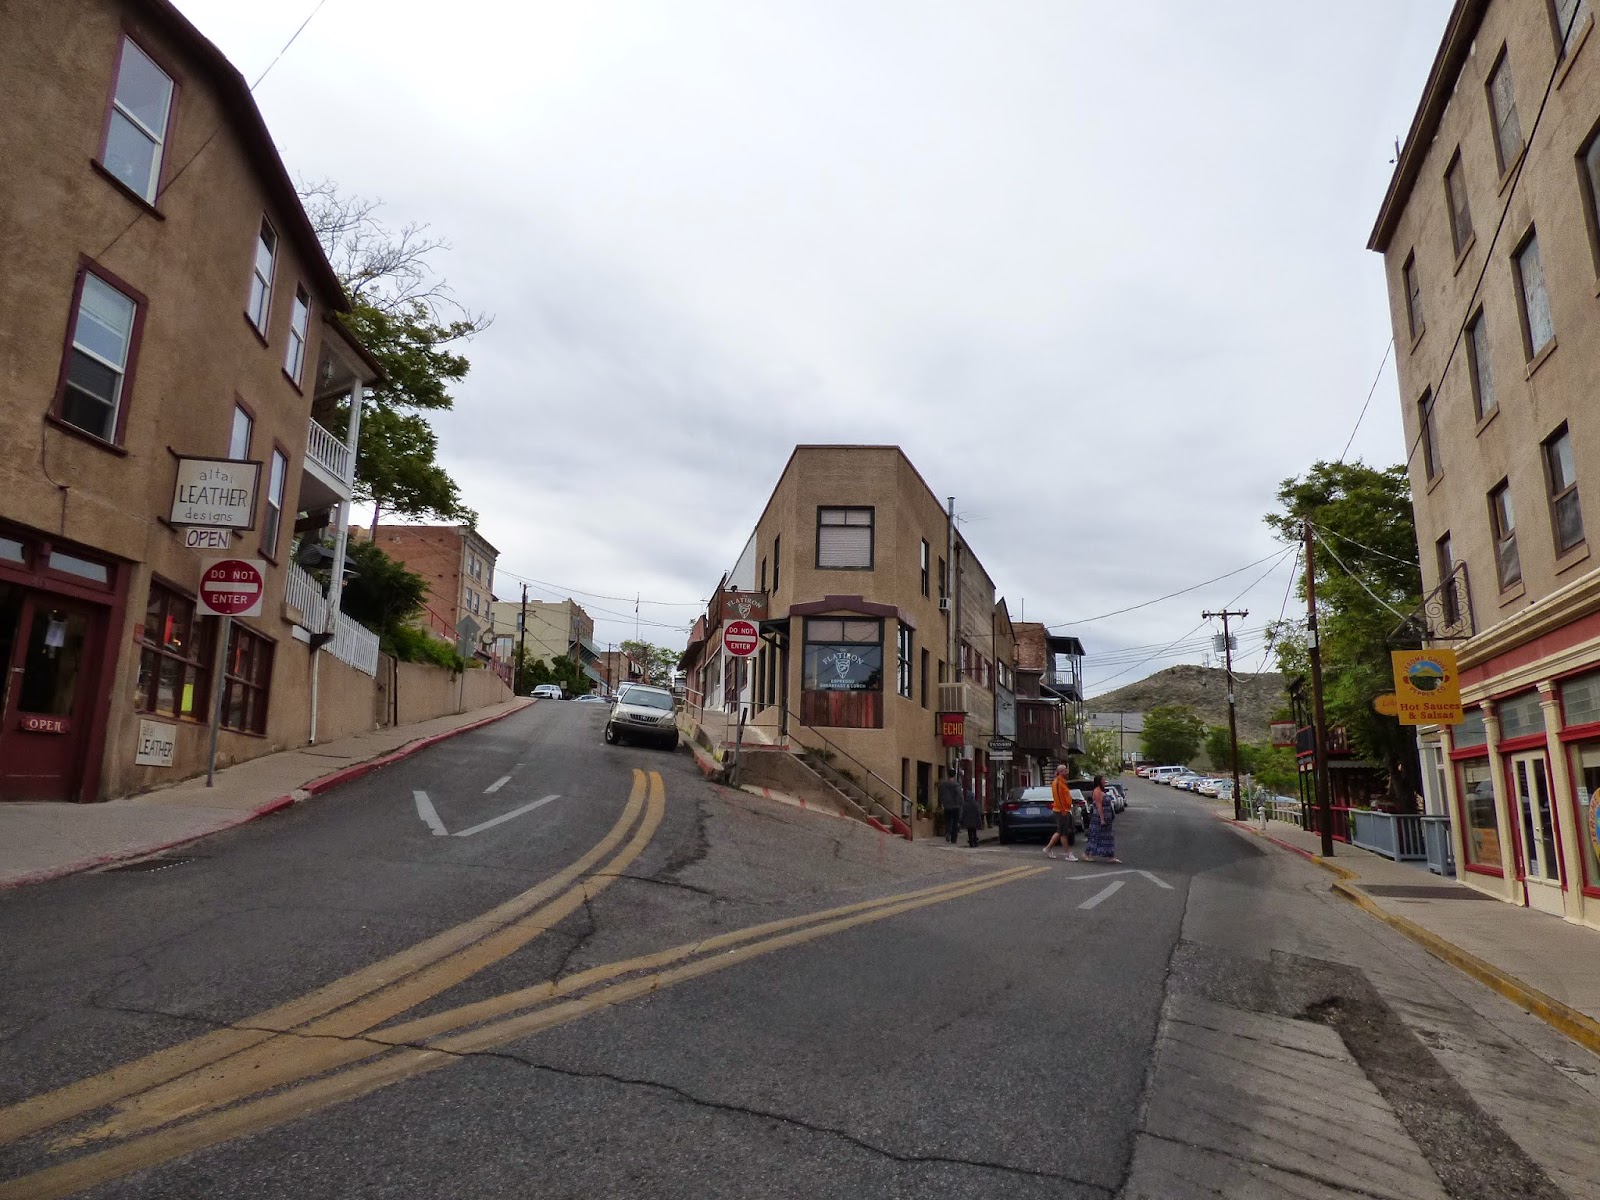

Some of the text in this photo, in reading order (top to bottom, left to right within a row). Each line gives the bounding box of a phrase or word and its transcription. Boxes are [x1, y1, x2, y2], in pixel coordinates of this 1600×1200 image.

[179, 484, 248, 507] LEATHER
[185, 506, 233, 523] designs
[187, 529, 229, 547] OPEN
[211, 569, 255, 580] DO NOT
[212, 594, 248, 604] ENTER
[726, 597, 763, 609] FLATIRON
[729, 626, 738, 634] DO
[730, 642, 751, 650] ENTER
[822, 652, 864, 665] FLATIRON
[1400, 702, 1460, 711] Hot Sauces
[1408, 711, 1454, 720] & Salsas
[29, 718, 62, 733] OPEN
[943, 722, 963, 735] ECHO
[138, 737, 174, 759] LEATHER
